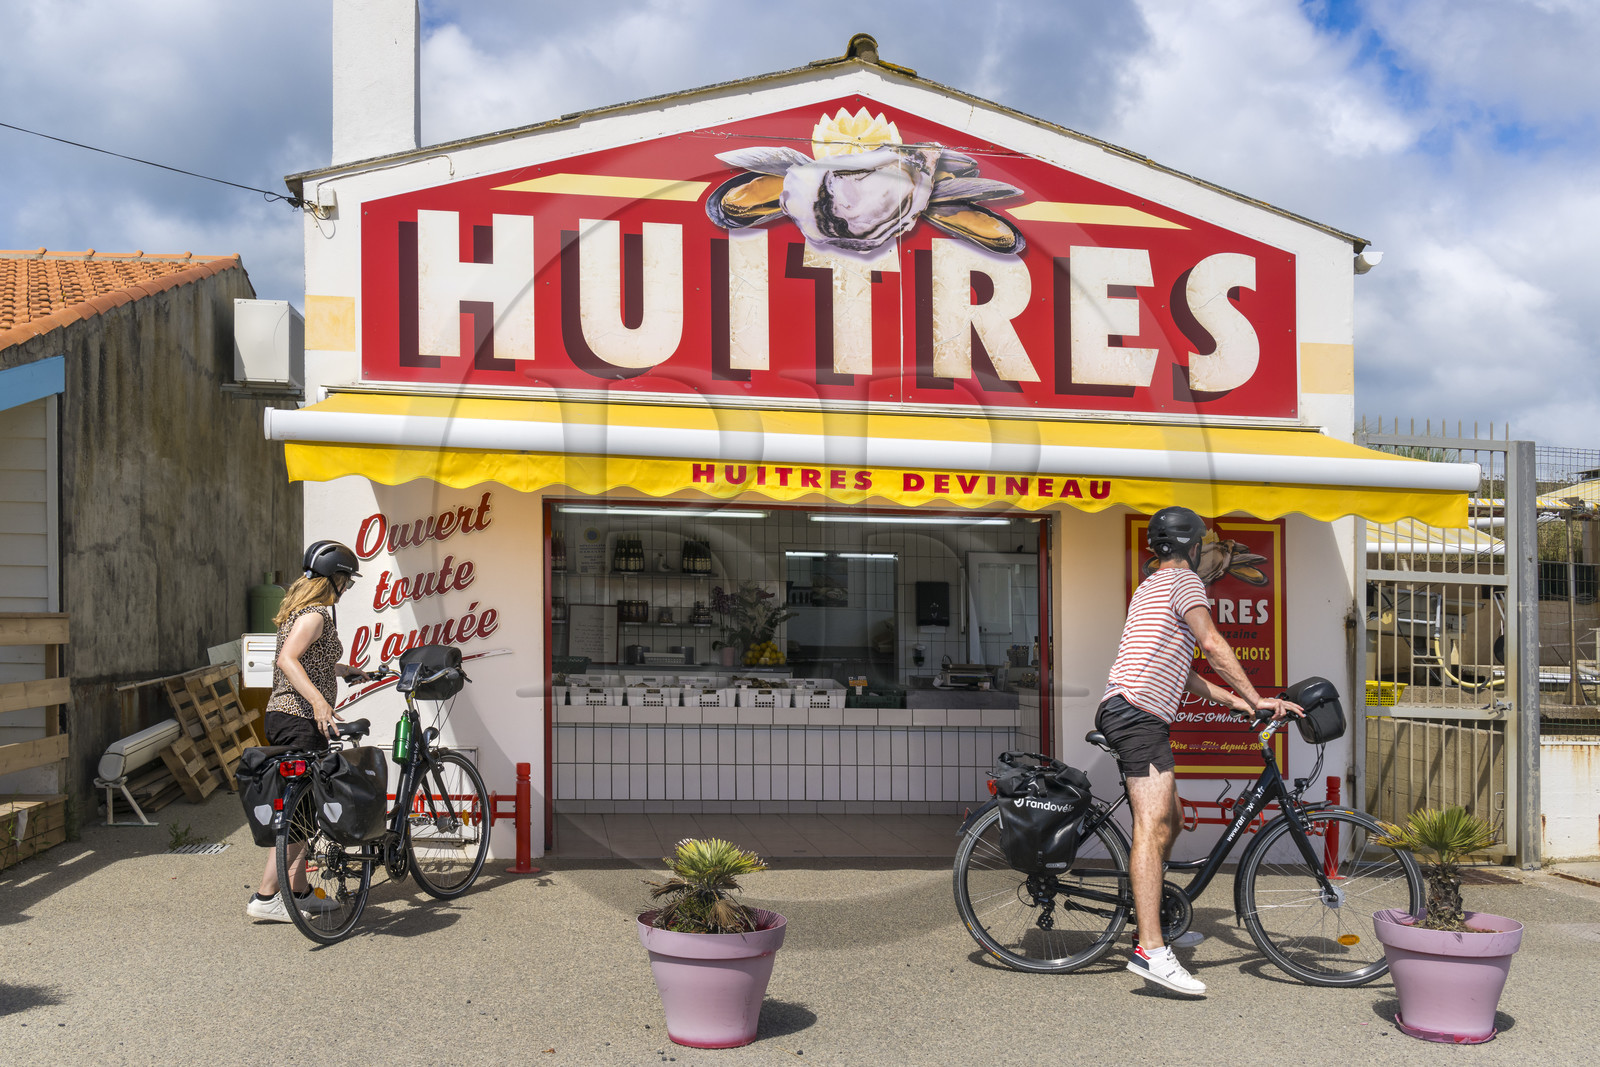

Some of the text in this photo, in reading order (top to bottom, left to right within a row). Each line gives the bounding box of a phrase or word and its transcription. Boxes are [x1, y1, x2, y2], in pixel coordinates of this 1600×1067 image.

[415, 207, 1261, 394] HUITRES
[691, 463, 1112, 500] HUITRES DEVINEAU
[355, 491, 492, 560] Ouvert
[373, 555, 476, 612] toute
[350, 601, 499, 668] l'année
[1220, 742, 1248, 753] depuis
